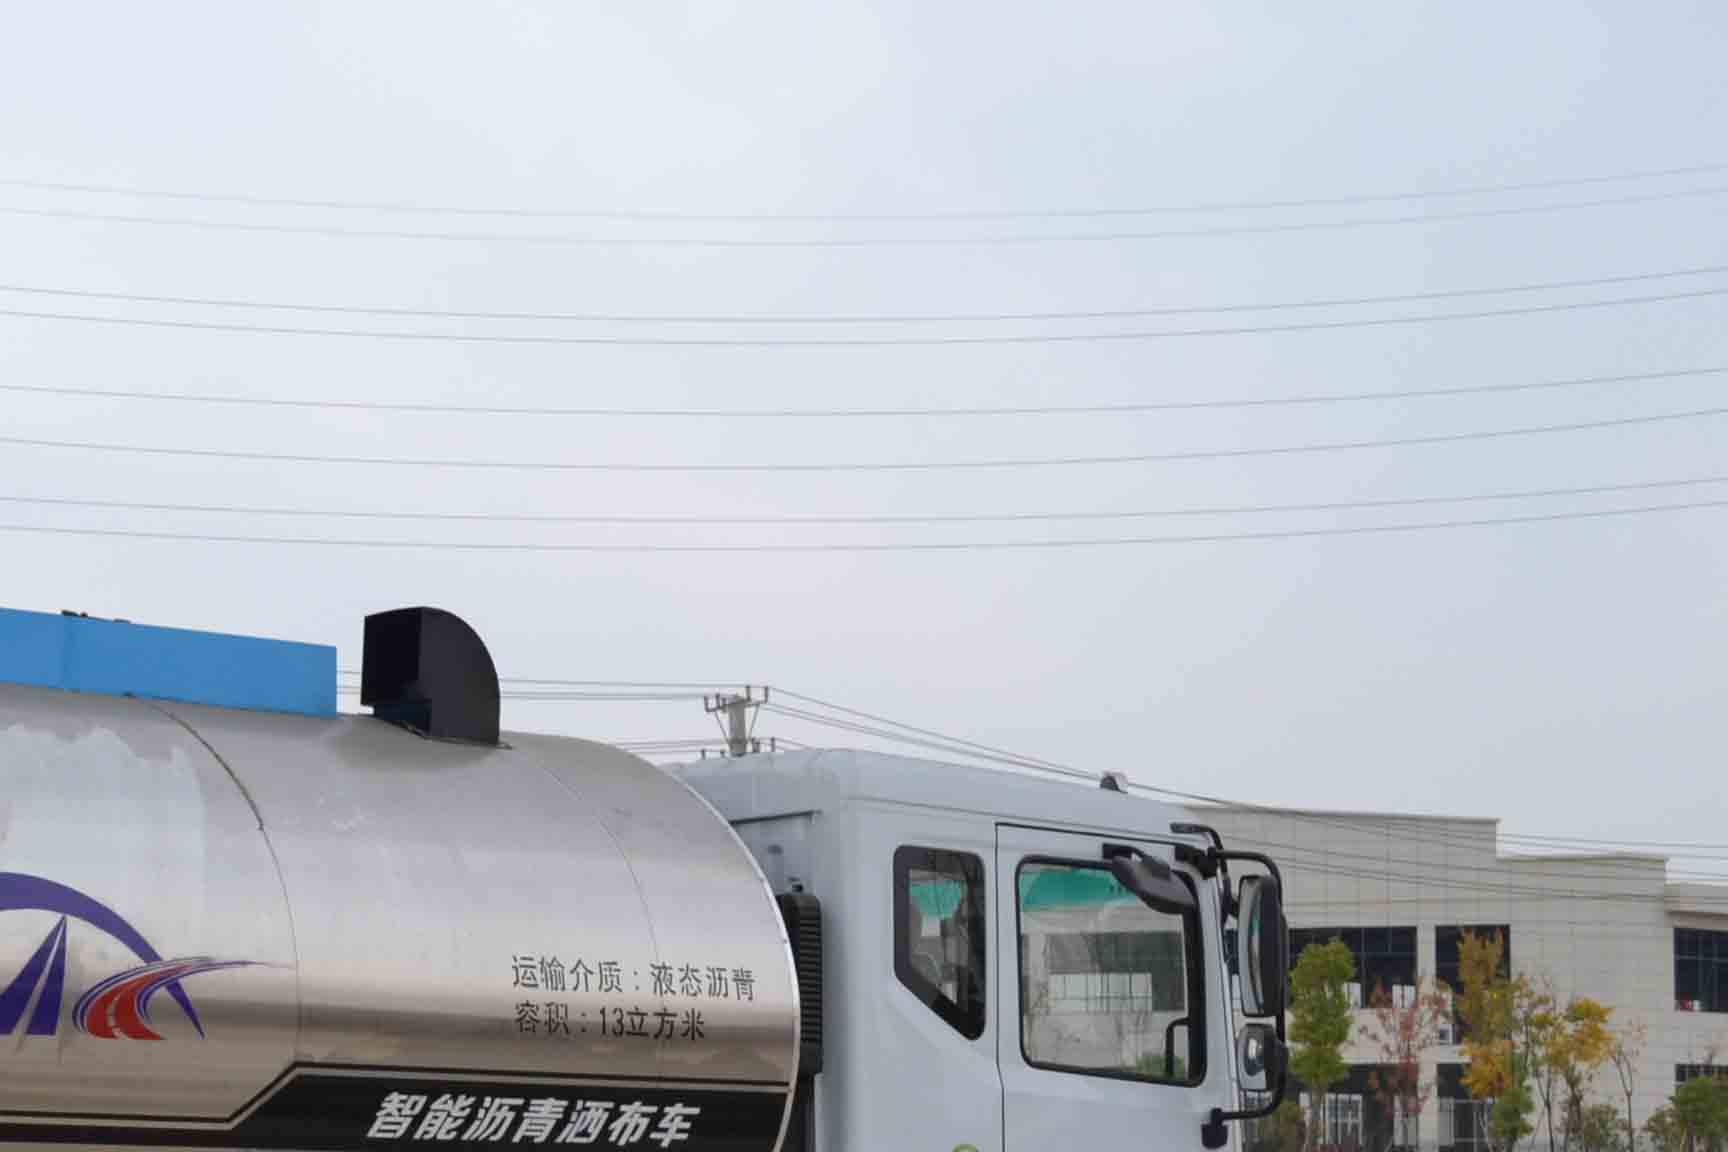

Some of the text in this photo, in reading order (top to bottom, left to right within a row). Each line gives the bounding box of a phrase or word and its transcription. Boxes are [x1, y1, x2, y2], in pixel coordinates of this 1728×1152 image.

[512, 955, 755, 1001] 运输介质：液态沥青
[514, 1000, 705, 1040] 容积：13立方米
[367, 1091, 701, 1147] 智能沥青洒布车
